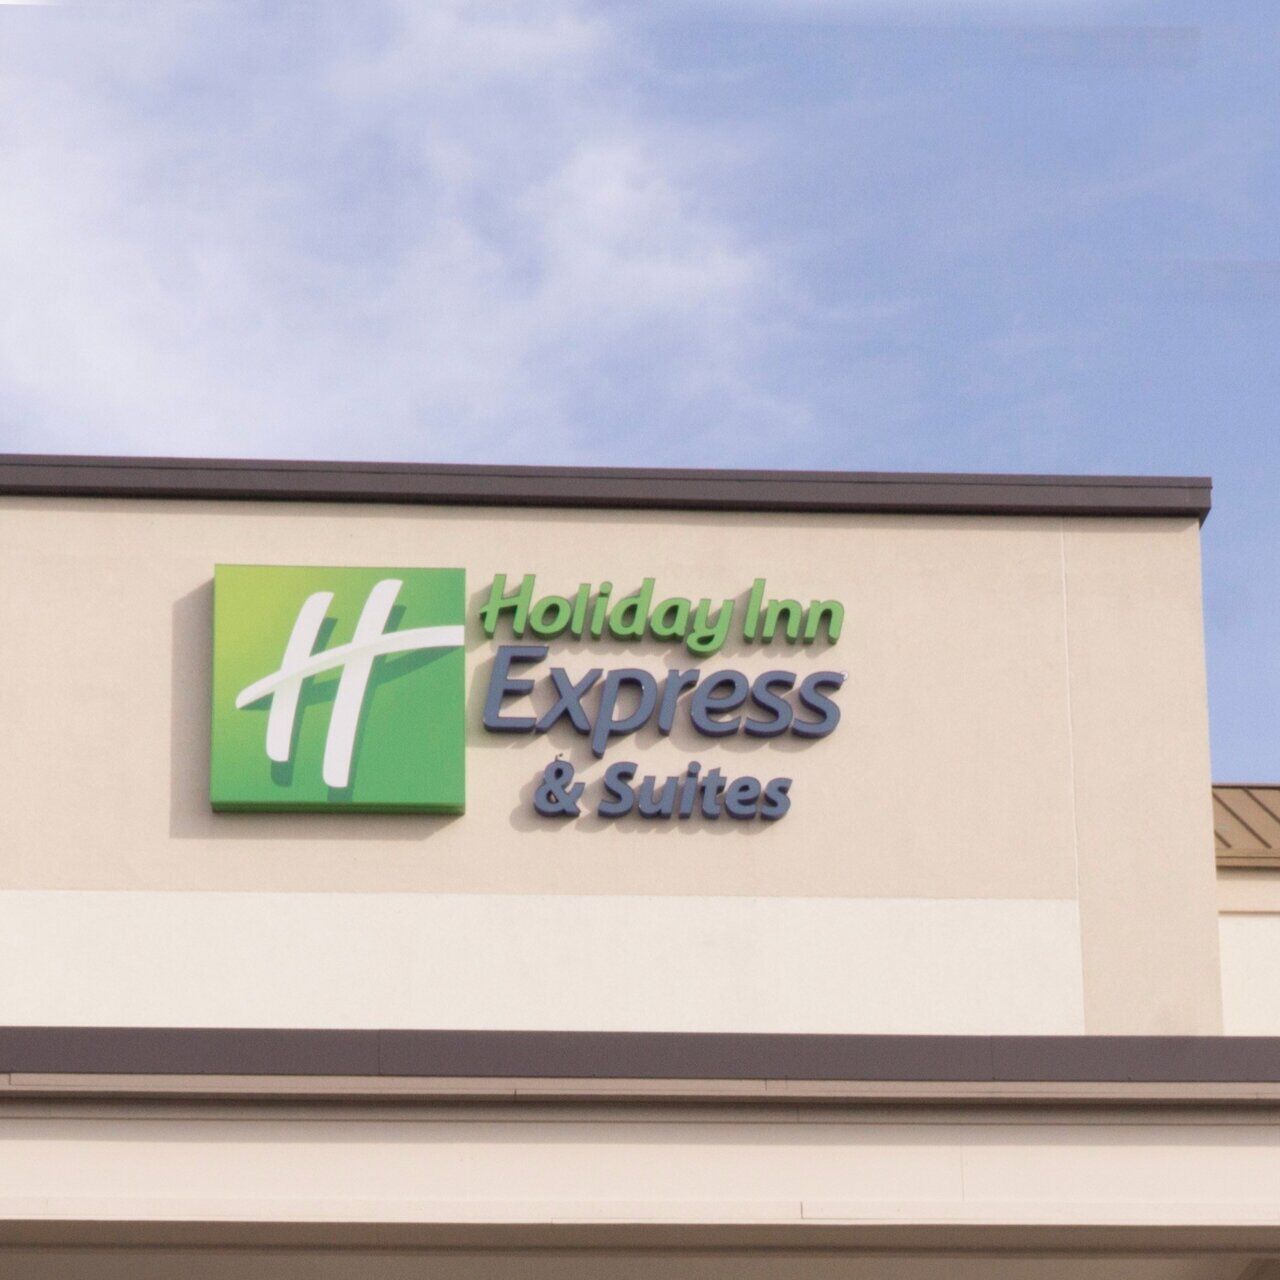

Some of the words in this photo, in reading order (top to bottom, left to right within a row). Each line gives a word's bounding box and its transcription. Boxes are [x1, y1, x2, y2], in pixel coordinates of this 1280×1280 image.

[480, 573, 734, 657] Holiday
[743, 578, 845, 645] Inn
[482, 644, 845, 760] Express
[533, 758, 586, 819] &
[597, 760, 793, 821] Suites
